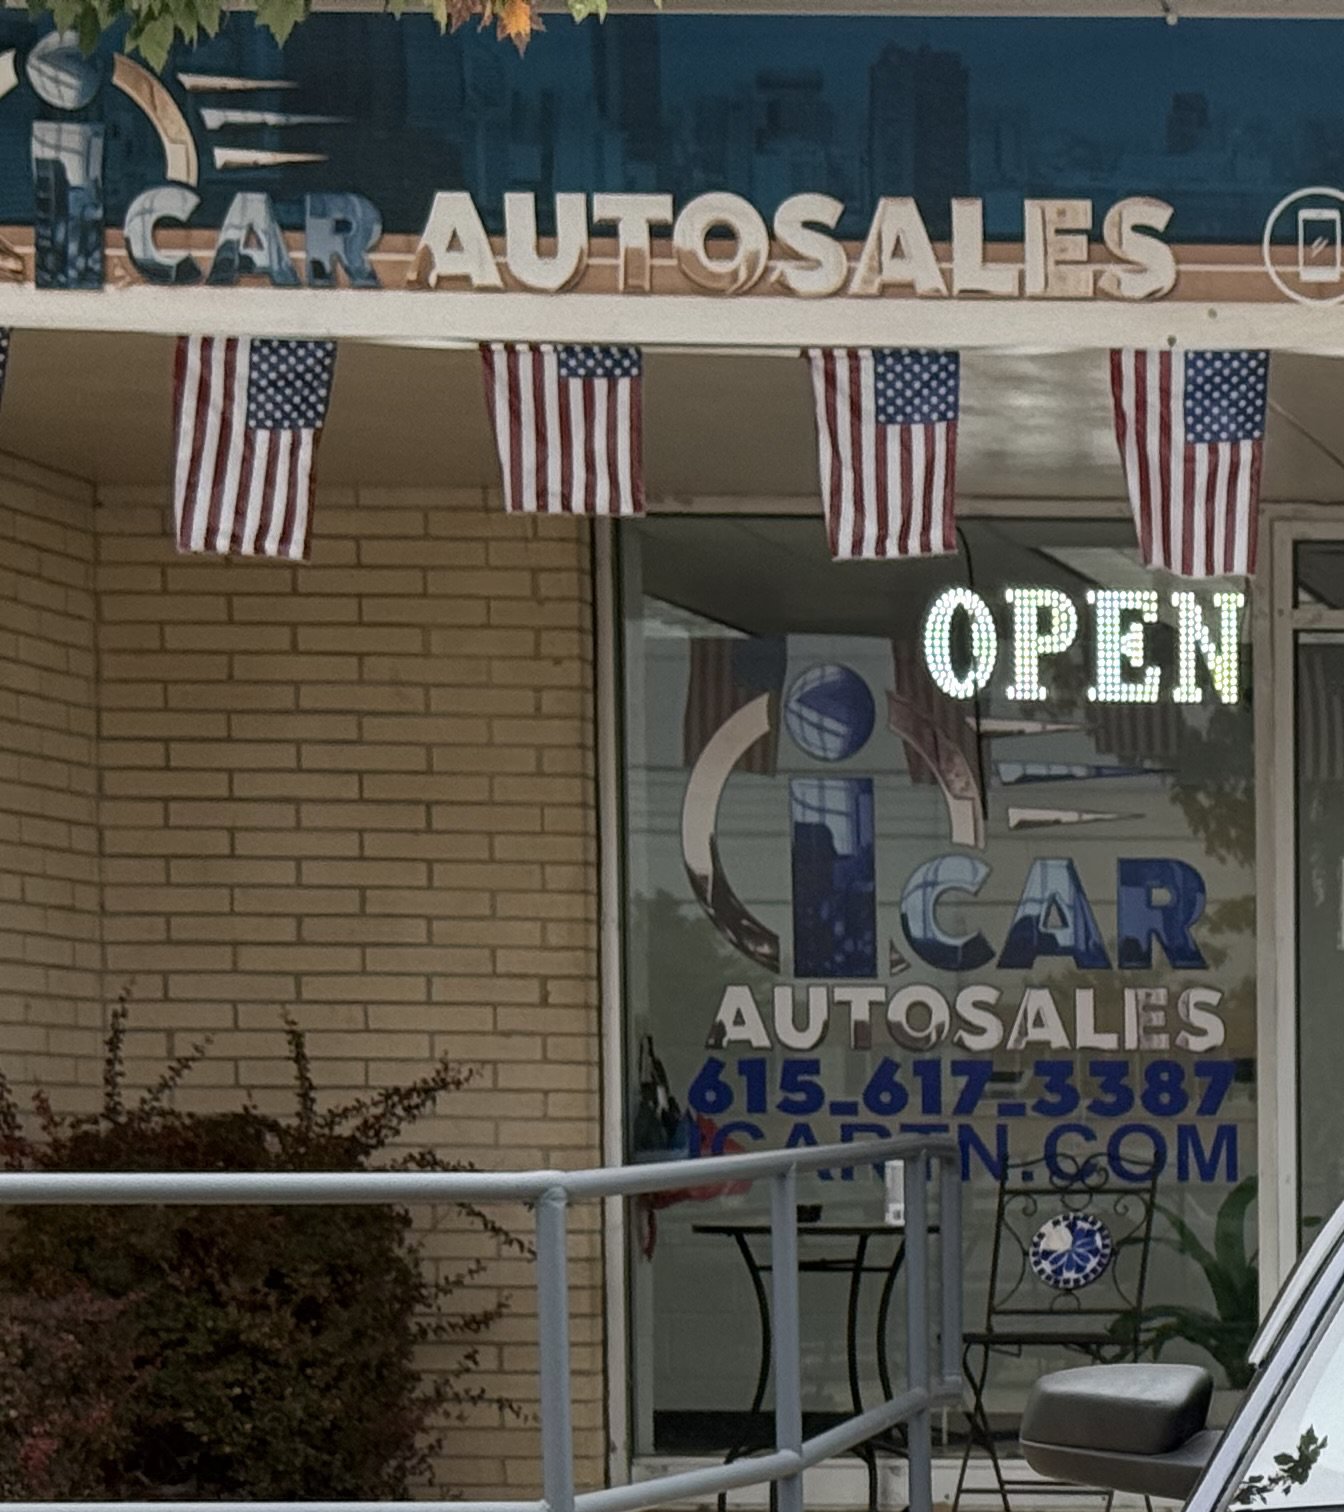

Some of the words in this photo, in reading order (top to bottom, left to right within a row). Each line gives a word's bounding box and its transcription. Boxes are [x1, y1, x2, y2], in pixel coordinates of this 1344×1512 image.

[409, 191, 1178, 300] AUTOSALES
[924, 586, 1244, 704] OPEN
[704, 984, 1226, 1052] AUTOSALES
